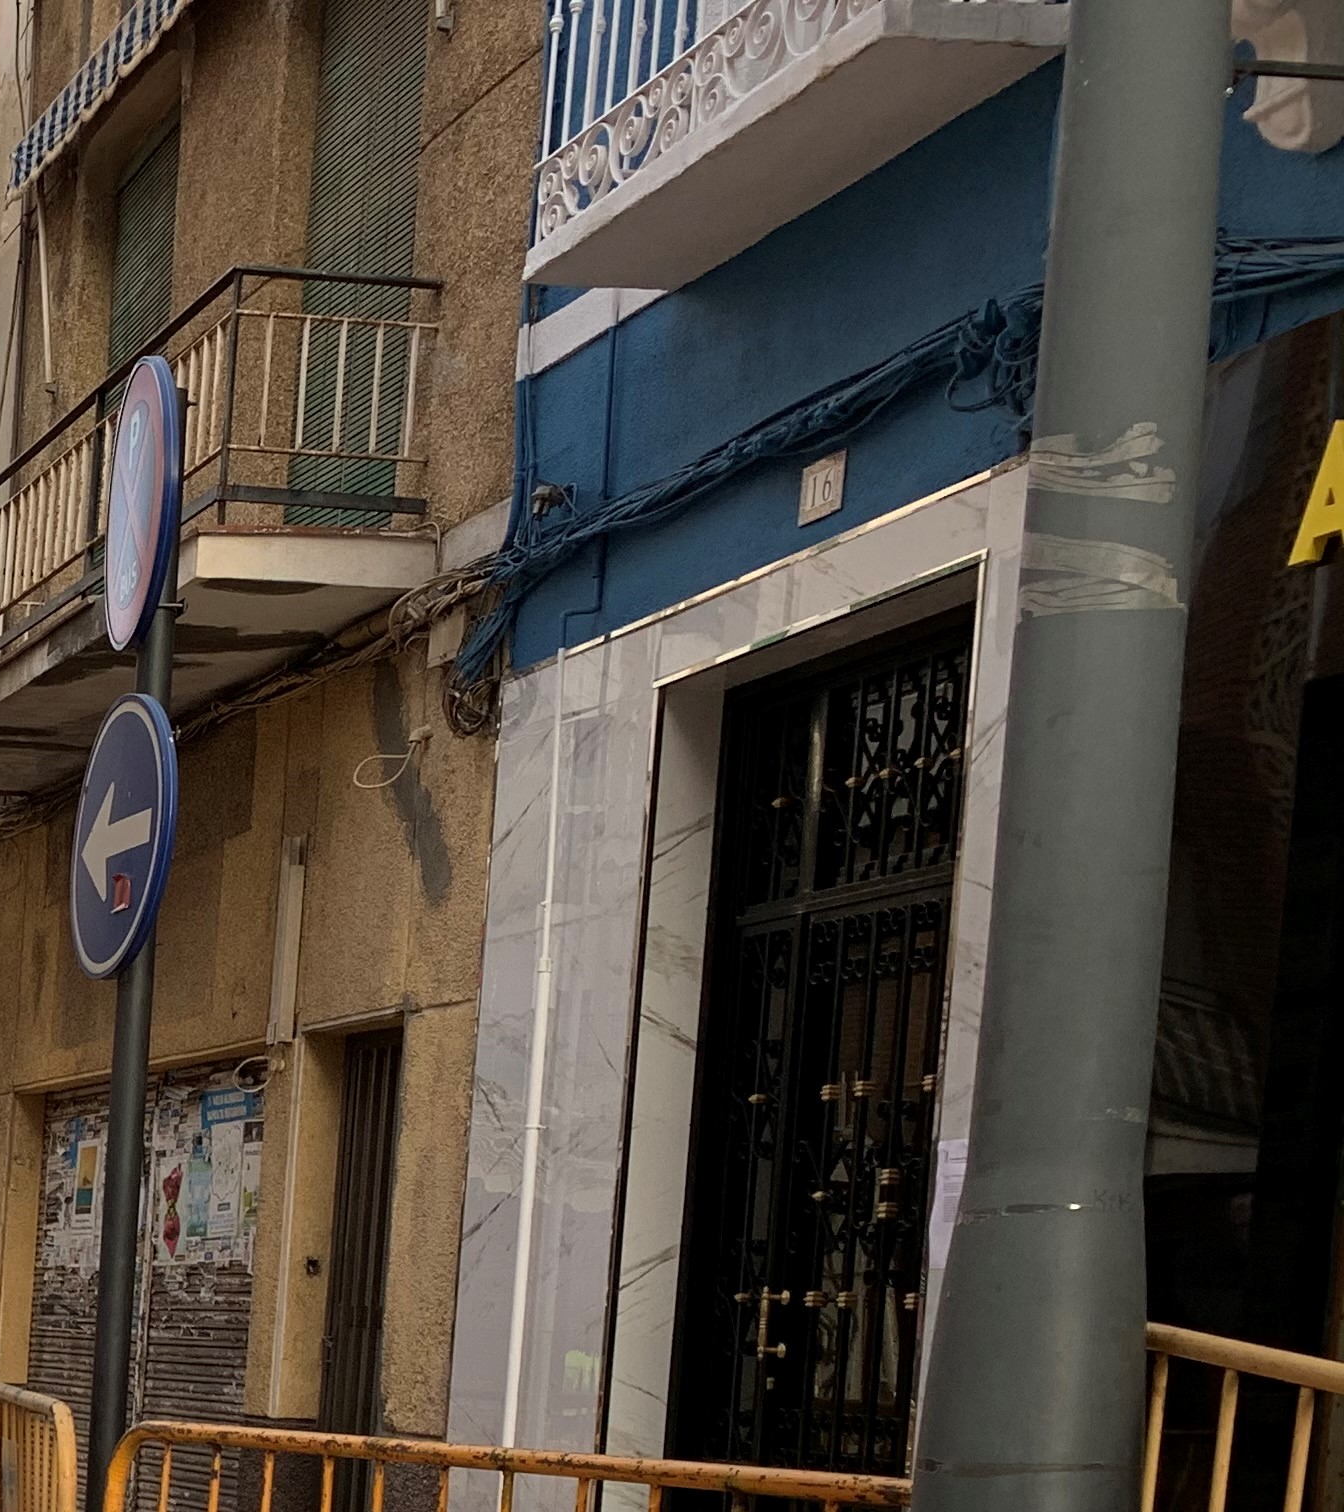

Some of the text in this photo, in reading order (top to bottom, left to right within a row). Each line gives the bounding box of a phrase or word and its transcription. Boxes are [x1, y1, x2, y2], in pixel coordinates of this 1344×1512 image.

[129, 408, 140, 472] P
[810, 466, 833, 508] 16
[119, 560, 138, 603] BUS
